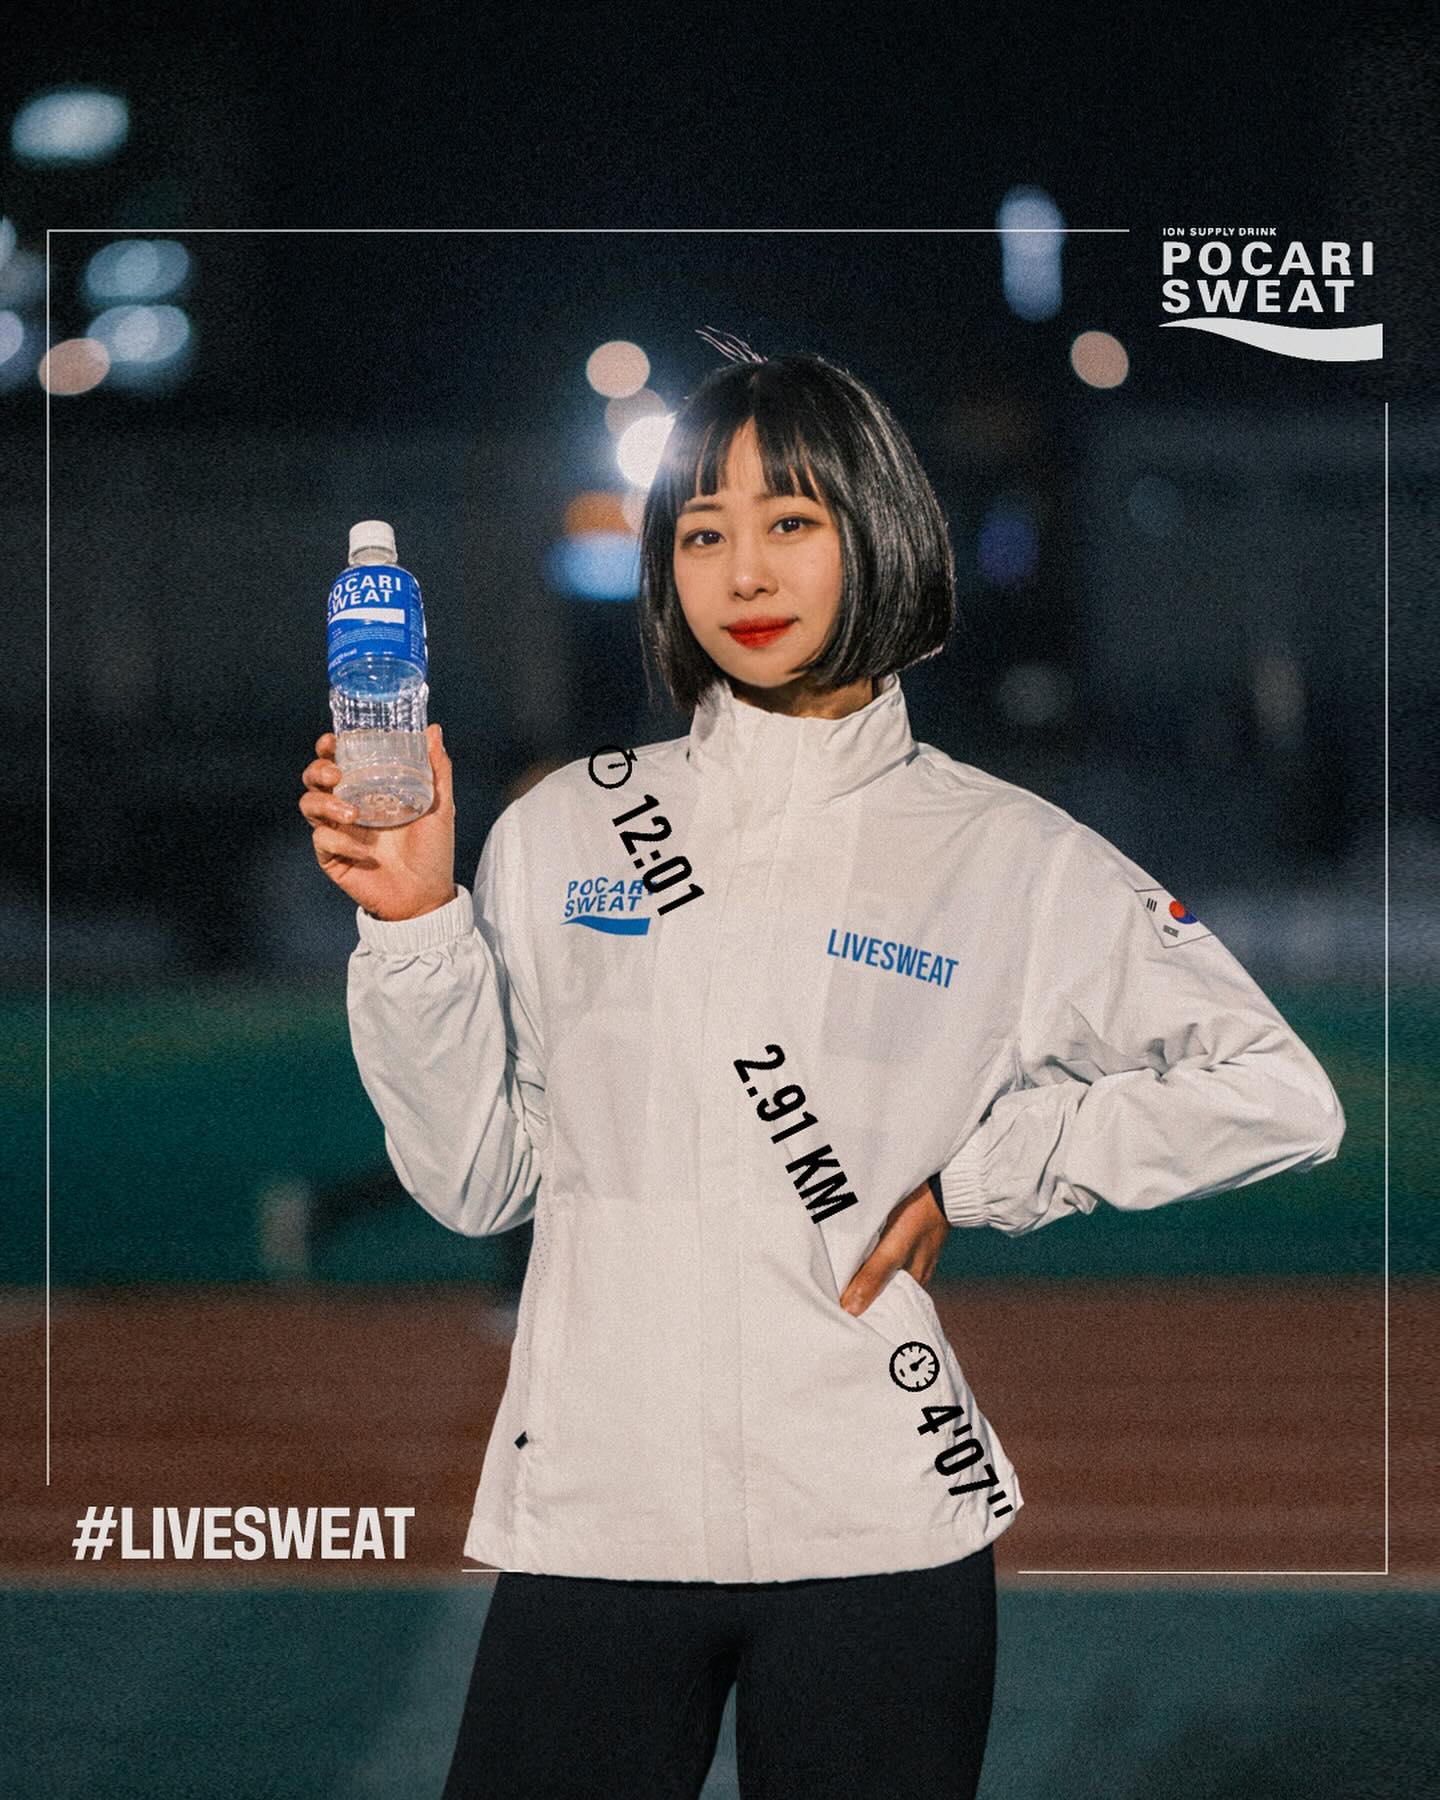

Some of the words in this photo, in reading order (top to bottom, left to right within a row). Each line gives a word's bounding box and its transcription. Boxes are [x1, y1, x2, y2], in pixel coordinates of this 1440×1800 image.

[567, 876, 654, 899] POCAR
[564, 894, 642, 918] SWEAT
[826, 928, 960, 989] LIVESWEAT
